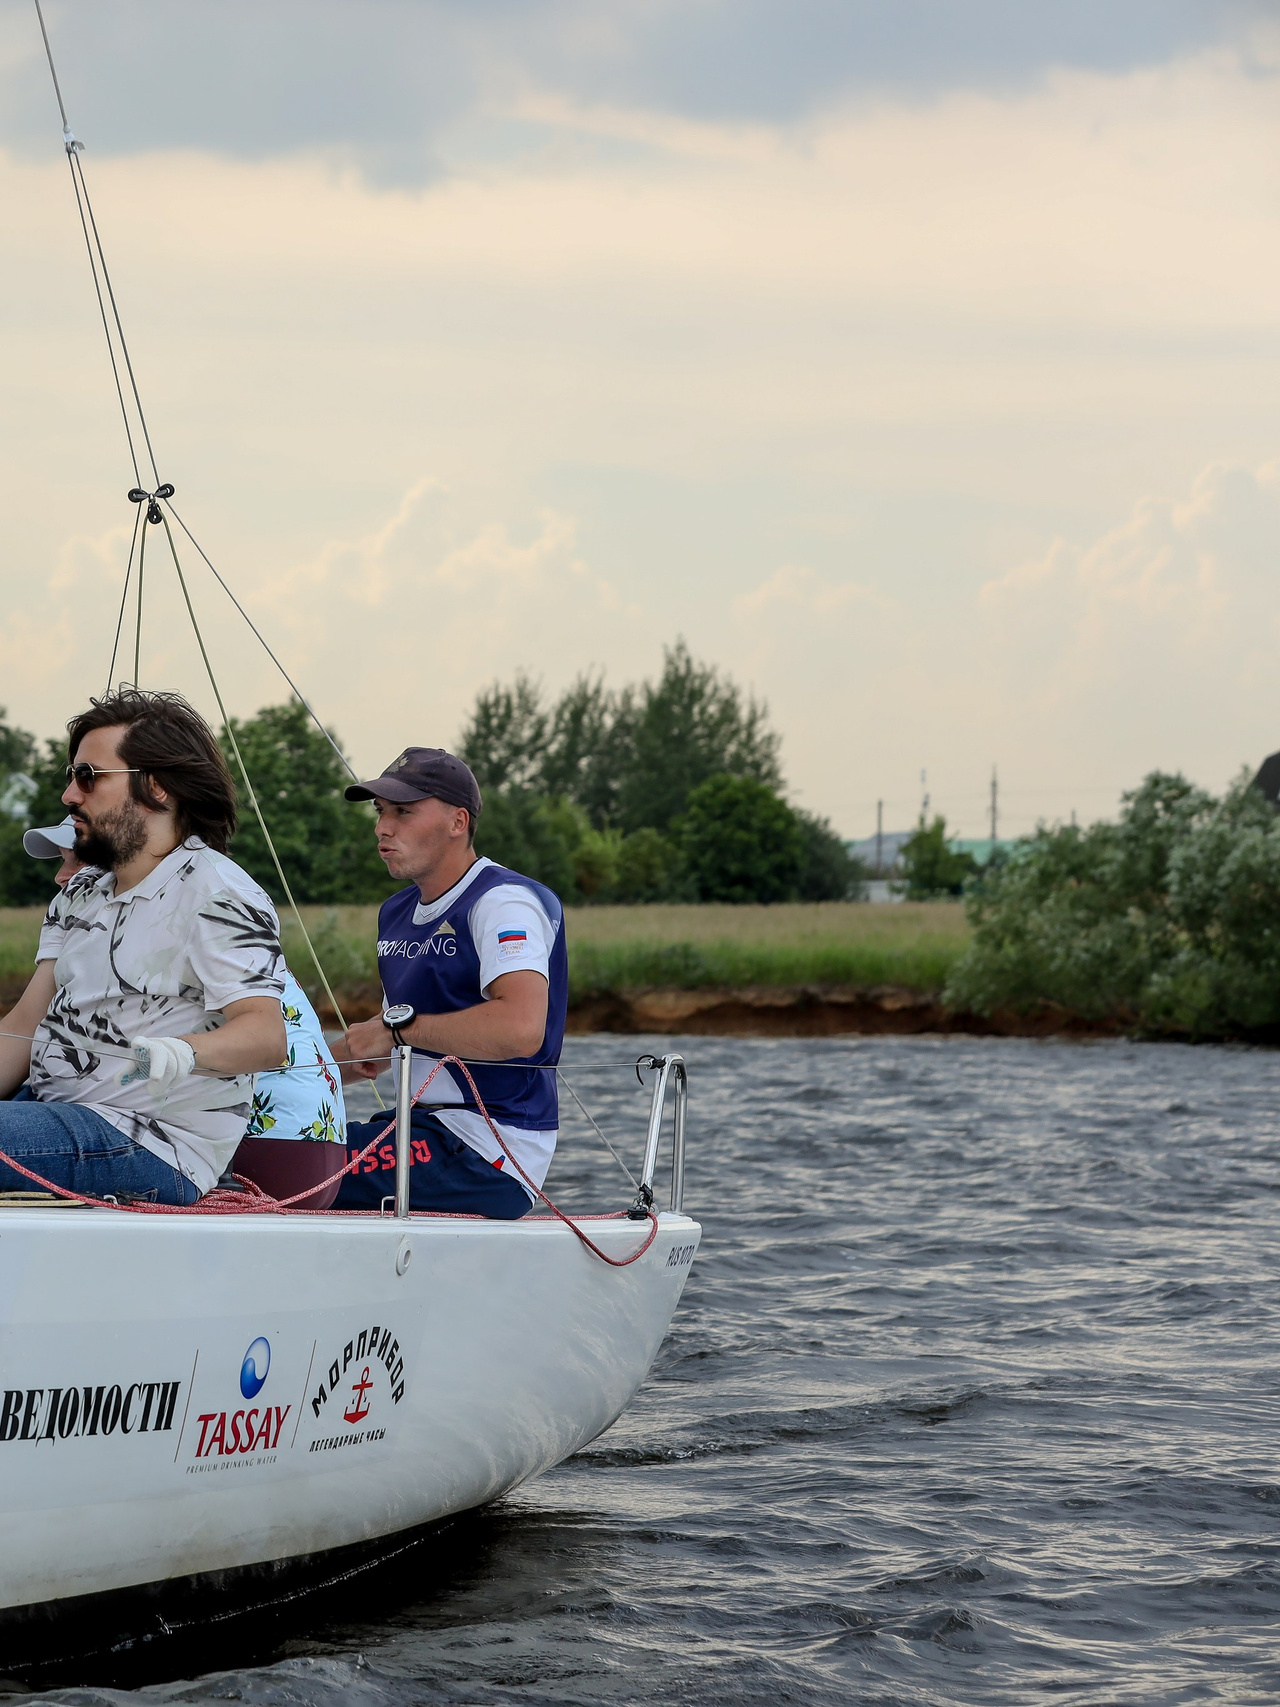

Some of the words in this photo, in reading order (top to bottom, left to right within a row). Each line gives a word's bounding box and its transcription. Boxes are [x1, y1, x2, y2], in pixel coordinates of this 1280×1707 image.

[311, 1326, 405, 1419] МОРПРИБОР
[194, 1404, 292, 1458] TASSAY
[308, 1431, 365, 1453] ЛЕГЕНДАРНЫЕ
[366, 1427, 387, 1442] ЧАСЫ
[186, 1463, 219, 1475] PREMIUM
[220, 1458, 255, 1471] DRINKING
[256, 1455, 278, 1467] WATER
